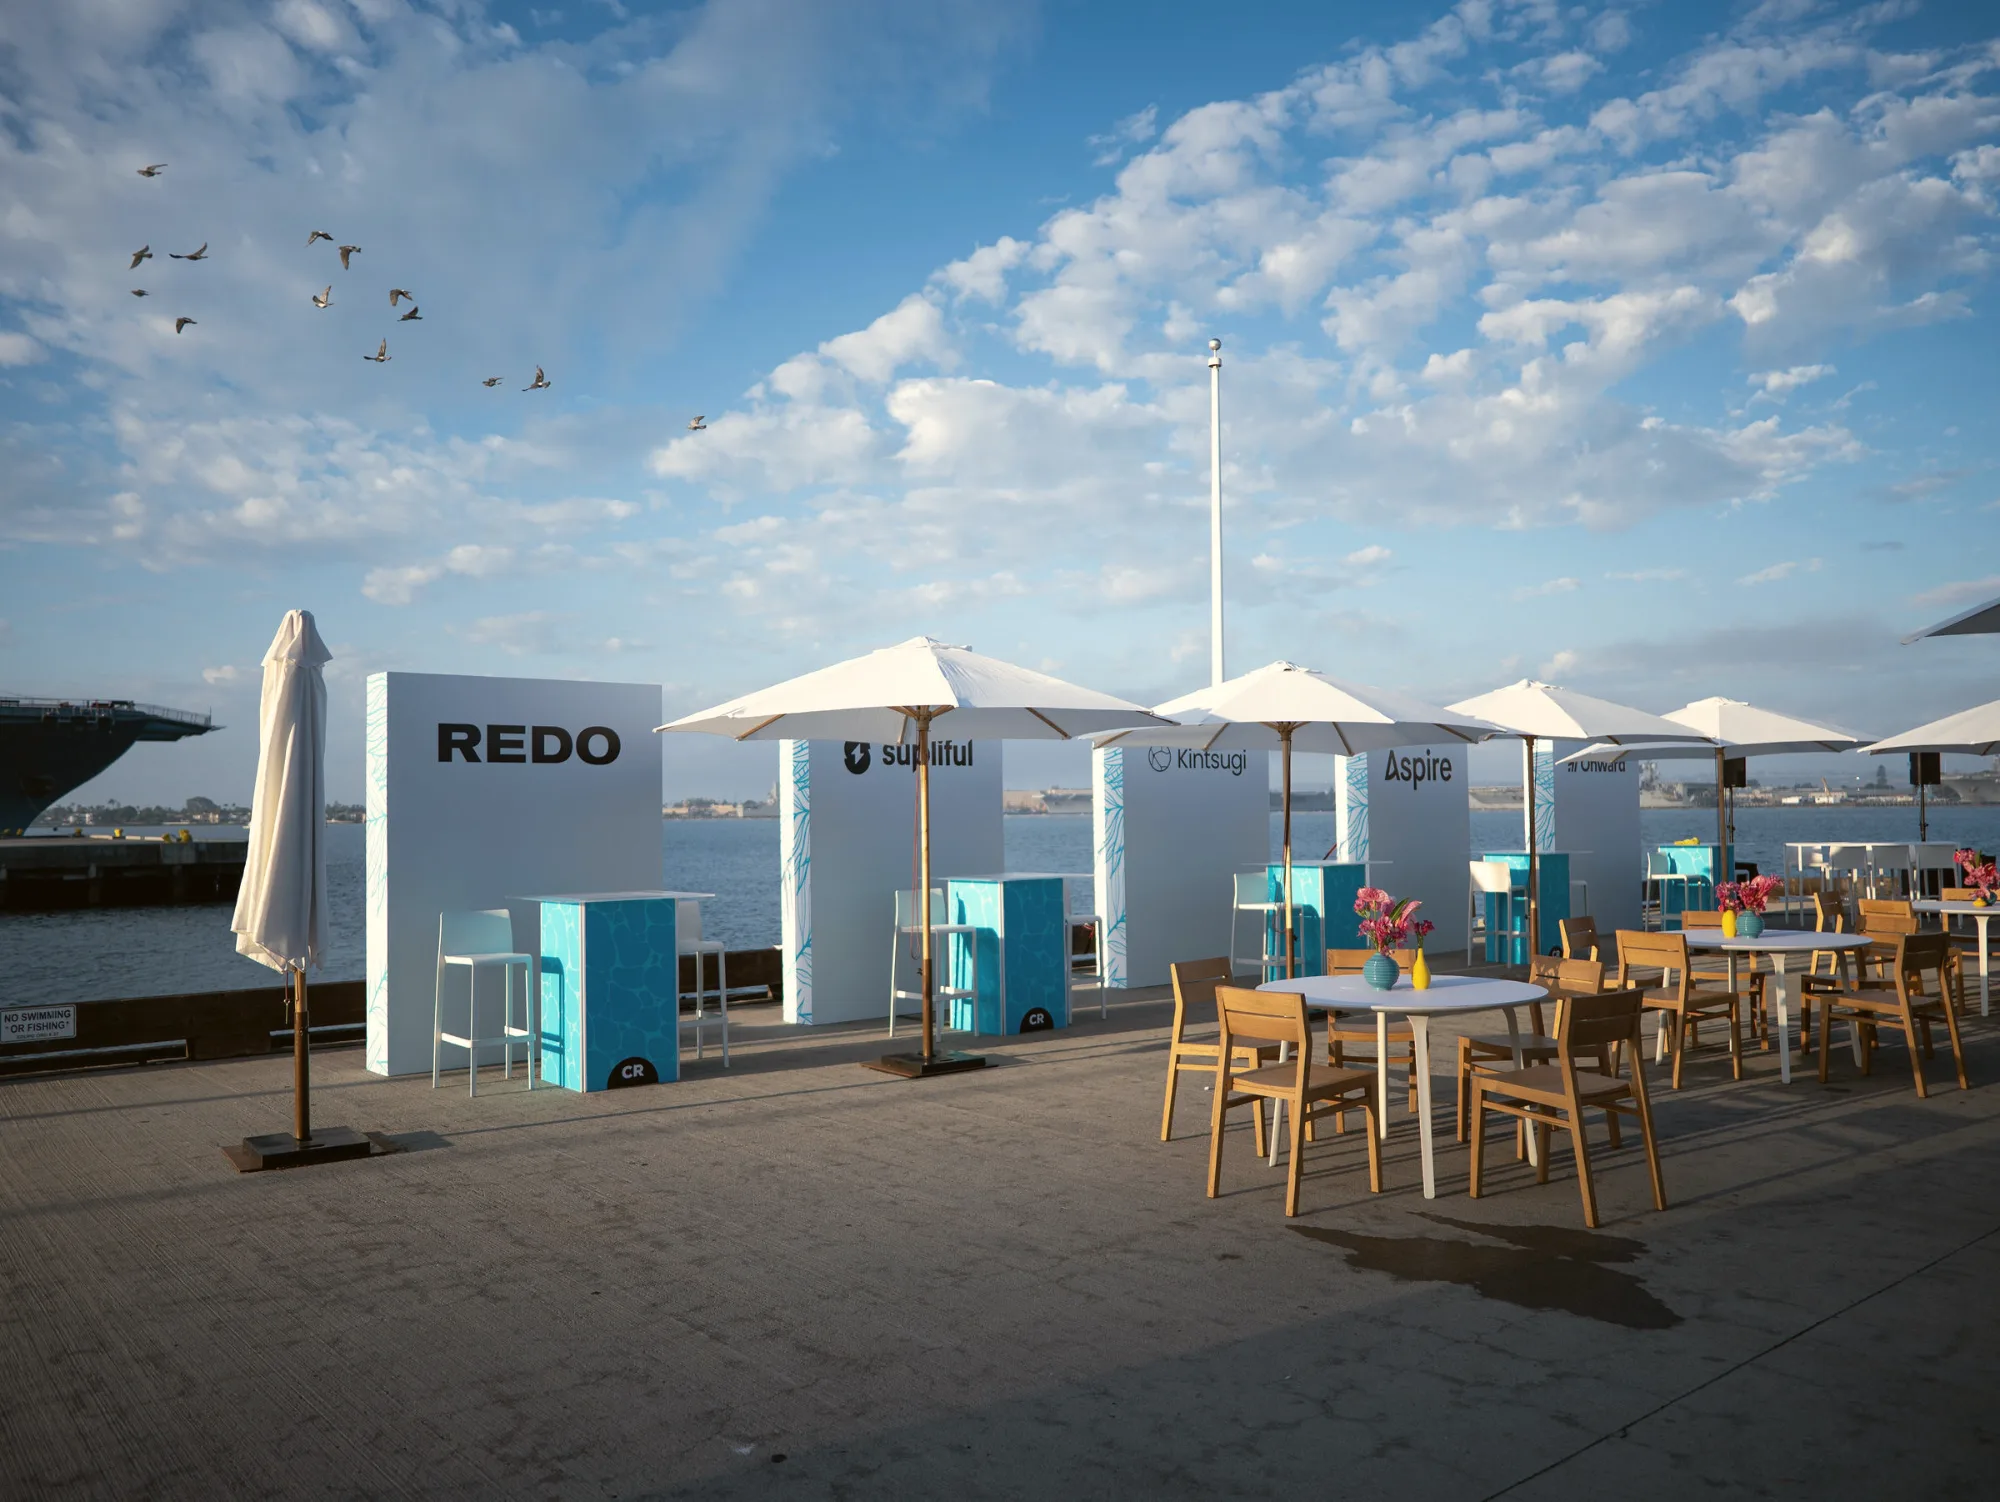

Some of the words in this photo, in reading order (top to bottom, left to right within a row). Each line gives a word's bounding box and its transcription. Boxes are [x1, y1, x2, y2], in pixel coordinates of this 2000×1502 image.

[438, 723, 621, 765] REDO
[1177, 748, 1247, 776] Kintsugi
[1384, 749, 1452, 790] Aspire
[1581, 760, 1626, 772] Onward
[4, 1013, 19, 1023] NO
[21, 1009, 71, 1022] SWIMMING
[1029, 1013, 1045, 1025] CR
[10, 1024, 25, 1033] OR
[27, 1020, 65, 1032] FISHING
[621, 1063, 644, 1079] CR
